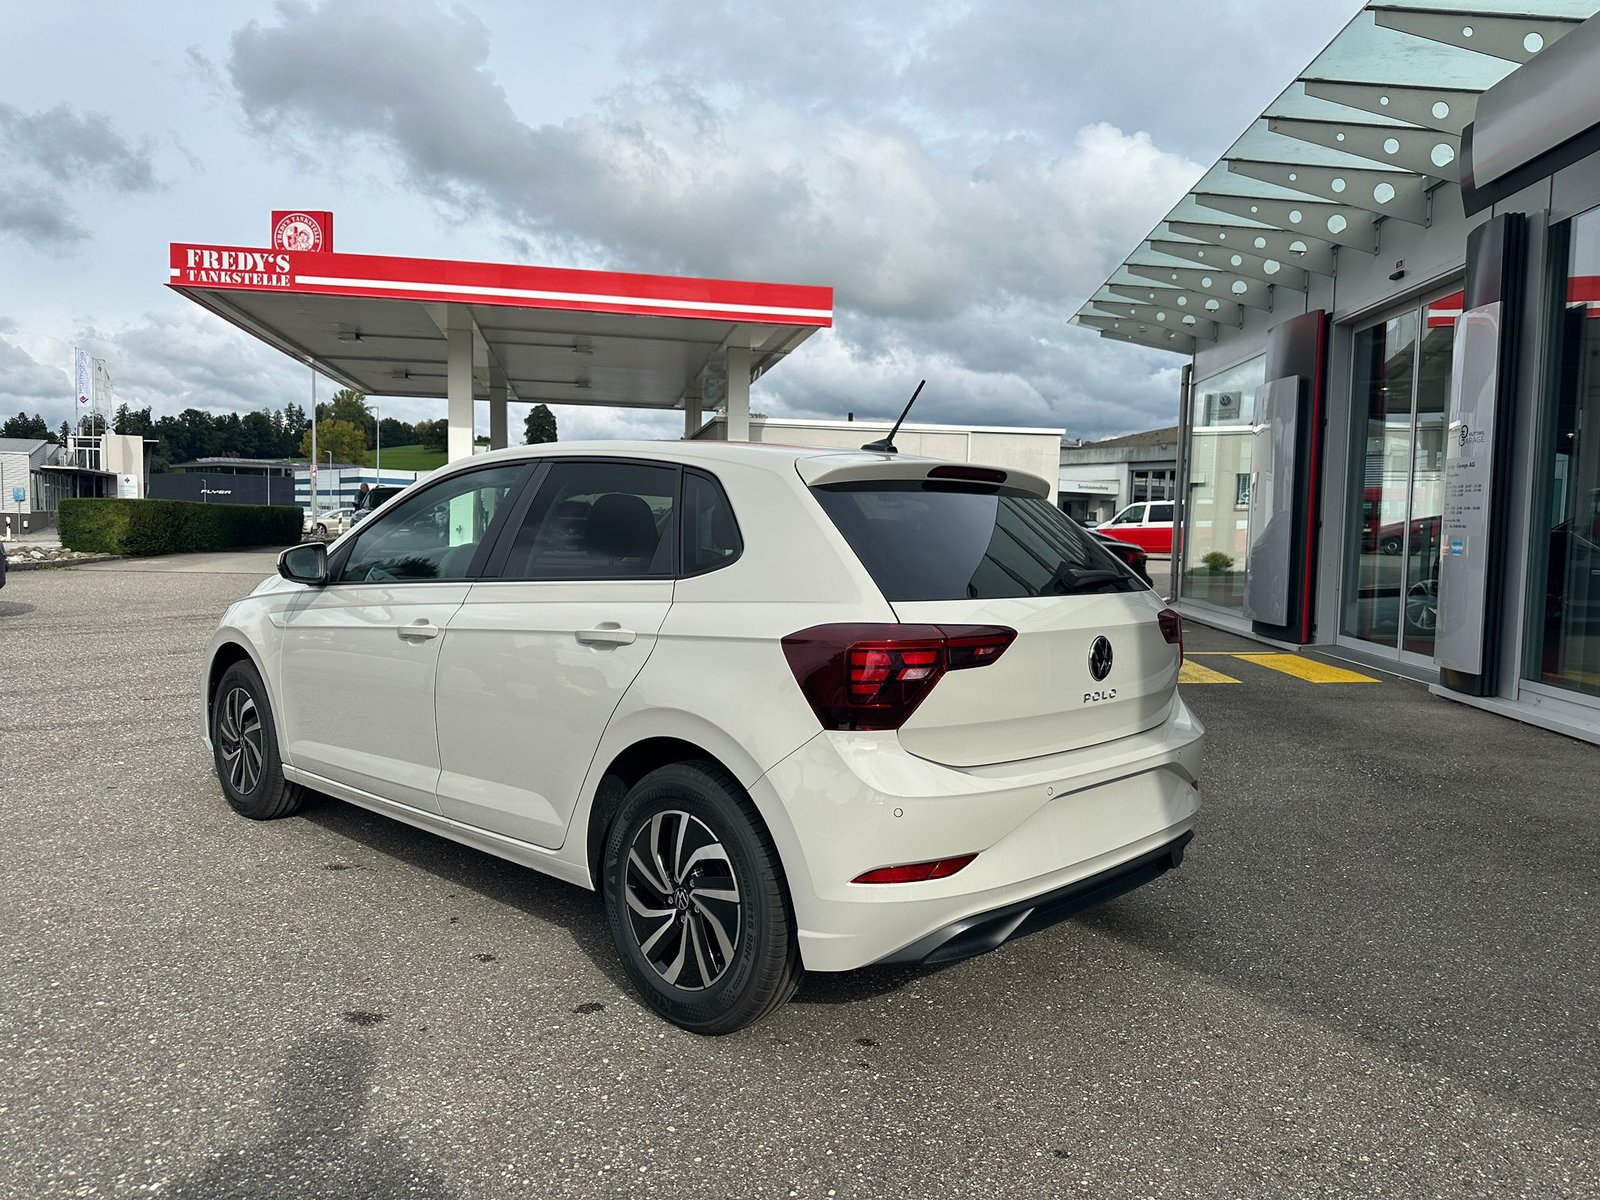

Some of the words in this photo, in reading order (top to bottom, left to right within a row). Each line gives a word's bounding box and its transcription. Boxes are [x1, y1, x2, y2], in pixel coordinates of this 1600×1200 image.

[291, 215, 320, 243] TANKSTELLE
[186, 249, 290, 273] FREDY'S
[187, 269, 290, 286] TANKSTELLE
[1083, 688, 1117, 703] POLO
